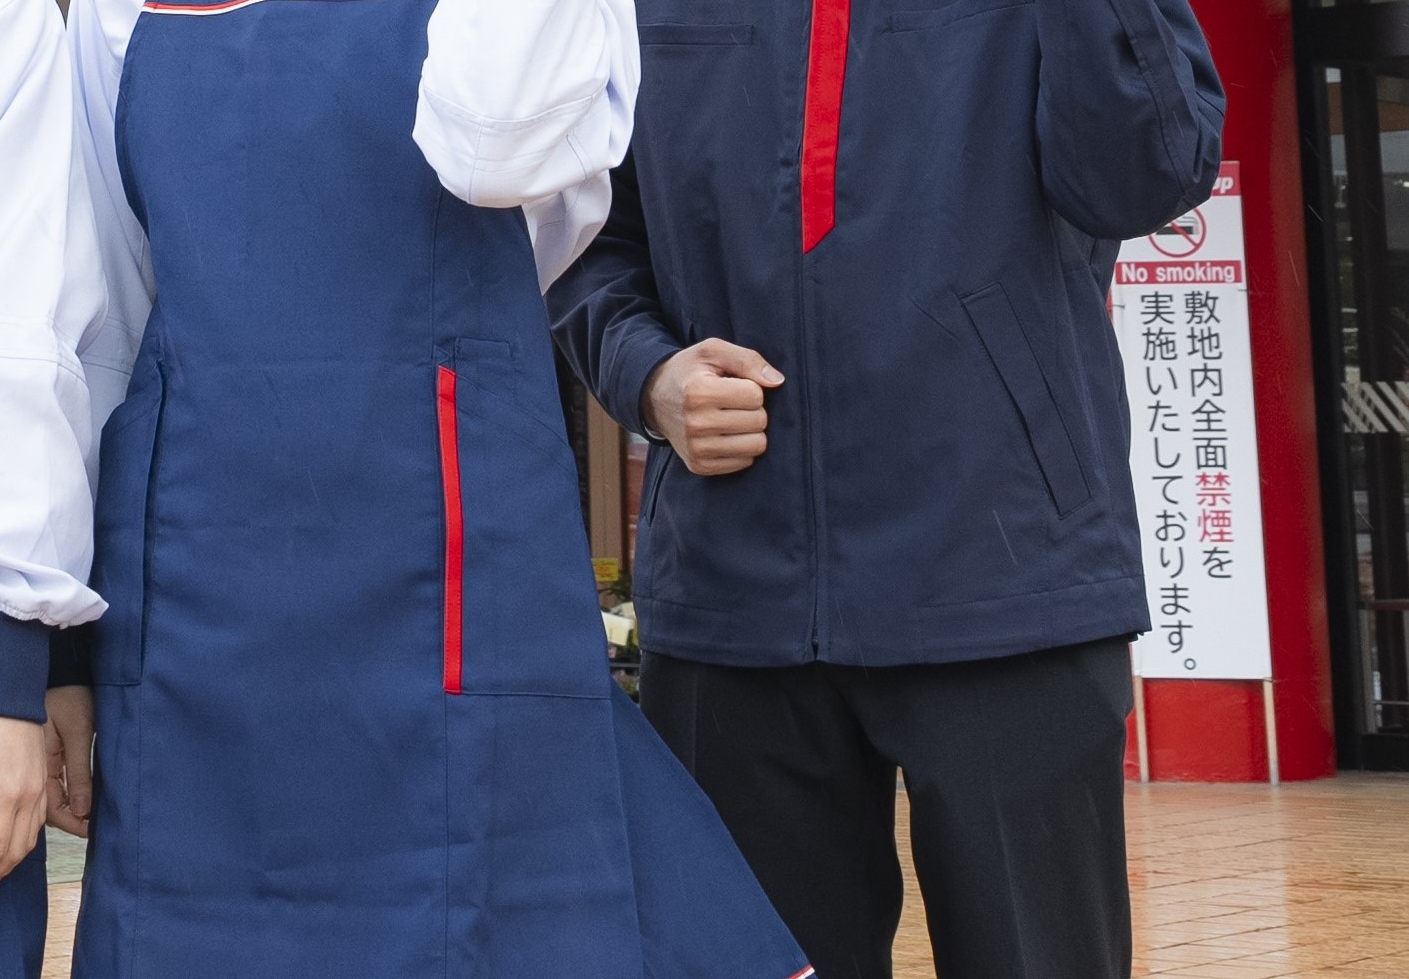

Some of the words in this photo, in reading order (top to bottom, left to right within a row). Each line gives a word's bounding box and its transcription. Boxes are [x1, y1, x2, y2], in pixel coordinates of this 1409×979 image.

[1121, 263, 1148, 282] No
[1156, 262, 1235, 282] smoking
[1140, 290, 1198, 671] 実施いたしております。
[1184, 290, 1234, 580] 敷地内全面禁煙を
